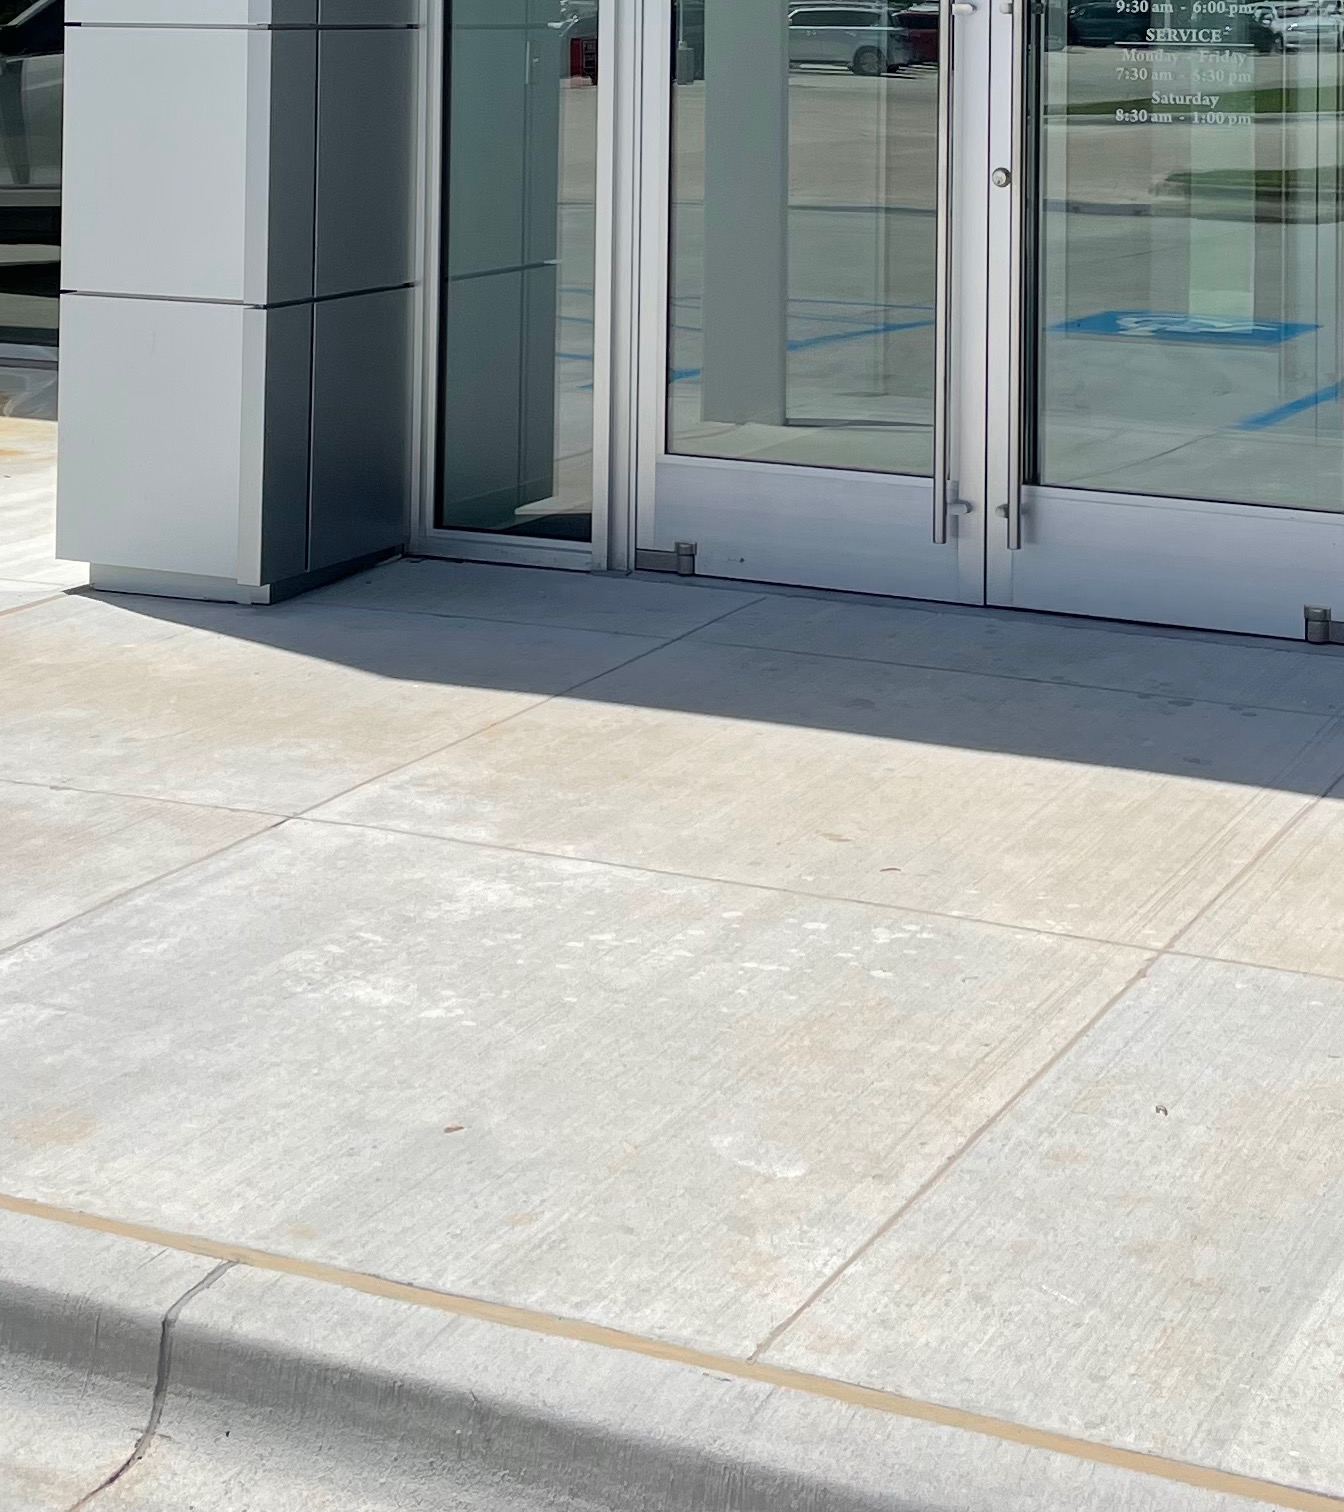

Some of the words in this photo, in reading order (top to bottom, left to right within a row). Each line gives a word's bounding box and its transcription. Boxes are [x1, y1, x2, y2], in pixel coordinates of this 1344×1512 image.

[1116, 0, 1149, 14] 9:30
[1151, 3, 1174, 14] am
[1192, 0, 1226, 14] 6:00
[1228, 3, 1253, 18] pm
[1145, 28, 1222, 43] SERVICE
[1121, 48, 1179, 65] Monday
[1199, 50, 1246, 67] Friday
[1116, 68, 1148, 81] 7:30
[1151, 71, 1173, 81] am
[1192, 69, 1225, 82] 5:30
[1228, 73, 1253, 87] pm
[1151, 91, 1220, 108] Saturday
[1115, 108, 1148, 122] 8:30
[1150, 112, 1173, 123] am
[1192, 111, 1225, 125] 1:00
[1227, 115, 1253, 127] pm
